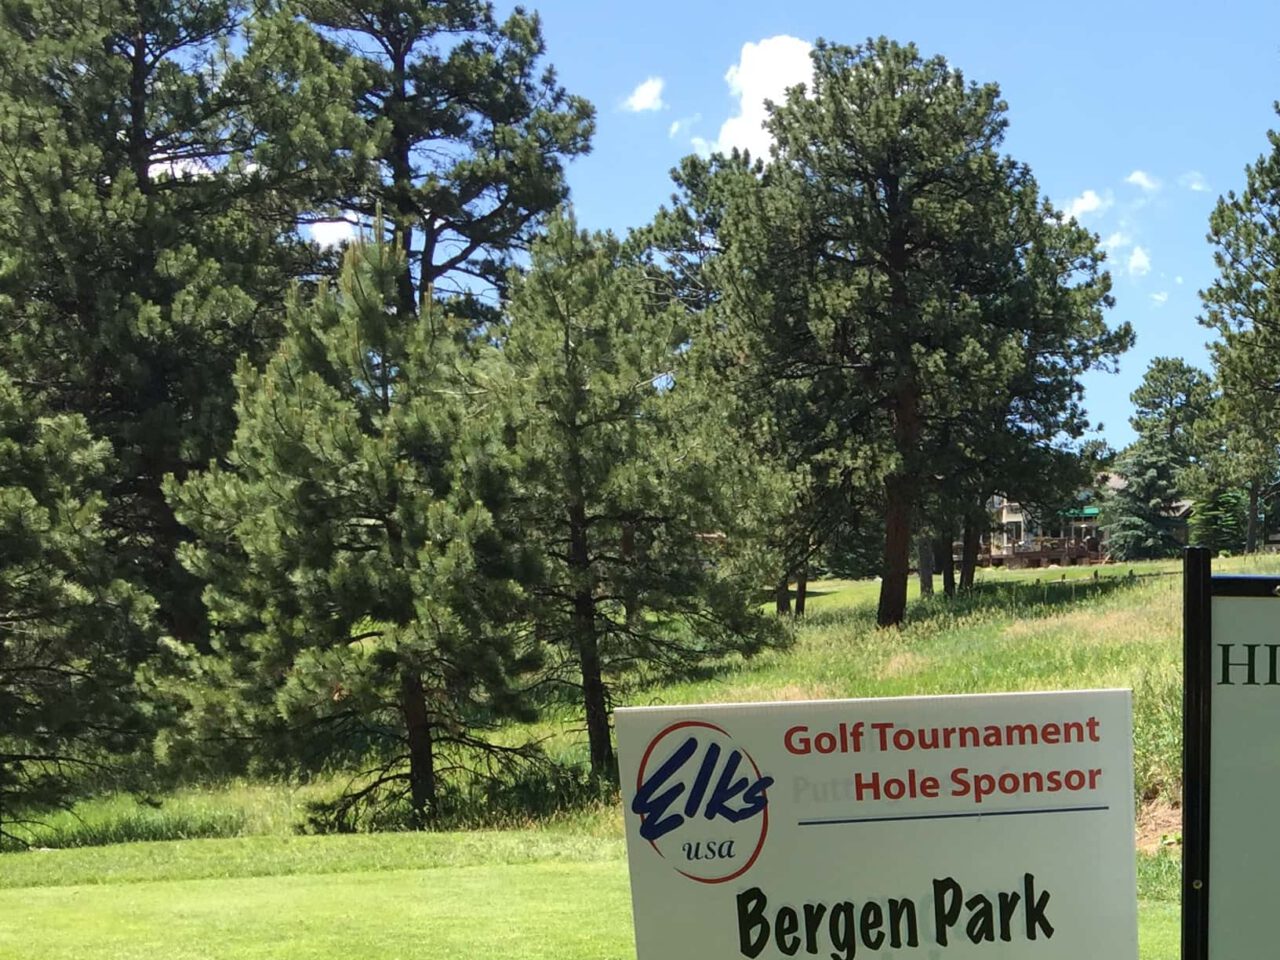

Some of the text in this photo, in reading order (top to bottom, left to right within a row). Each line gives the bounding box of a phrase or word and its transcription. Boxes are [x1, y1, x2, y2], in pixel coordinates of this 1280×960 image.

[784, 717, 1100, 754] Golf Tournament
[631, 736, 775, 841] Elks
[855, 769, 939, 801] Hole
[951, 768, 1102, 803] Sponsor
[682, 839, 737, 861] usa
[933, 873, 1054, 947] Park
